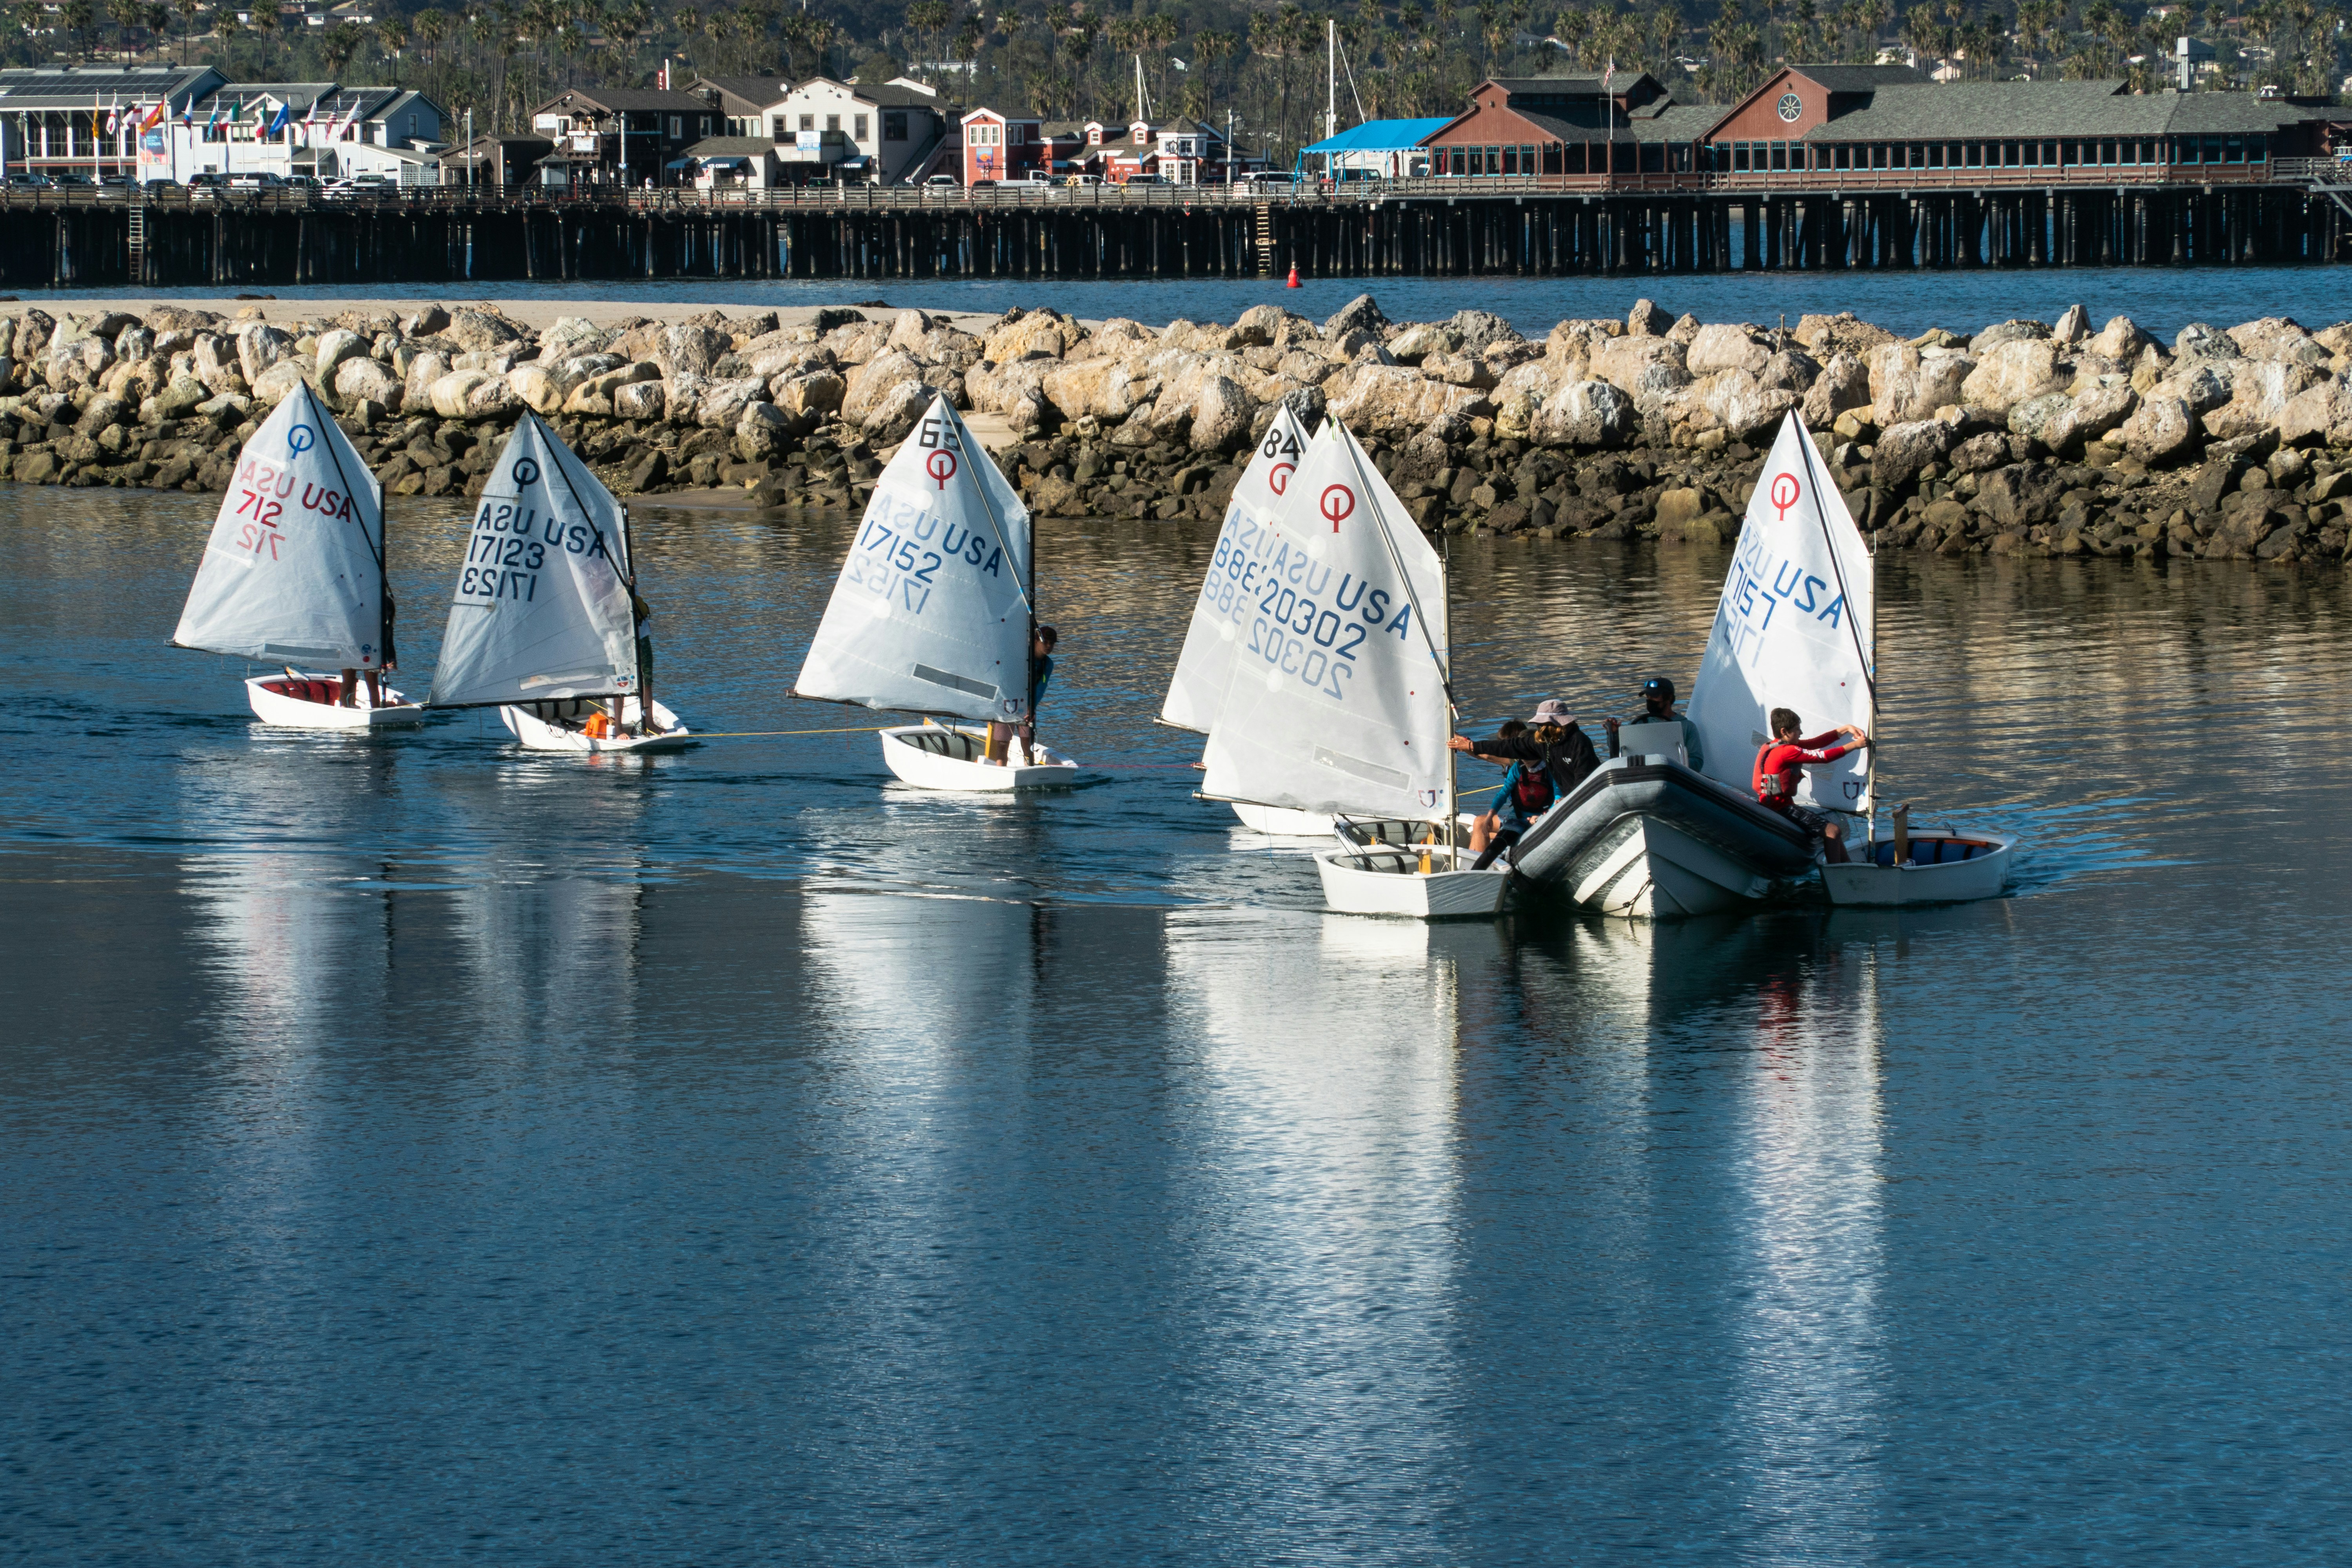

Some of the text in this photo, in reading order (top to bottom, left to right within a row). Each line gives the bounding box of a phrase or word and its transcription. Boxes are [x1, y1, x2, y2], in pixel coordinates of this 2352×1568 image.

[1264, 428, 1301, 461] 84
[236, 489, 283, 529] 712
[301, 482, 352, 523] USA
[469, 535, 546, 570] 17123
[545, 518, 605, 559] USA
[860, 520, 943, 584] 17152
[942, 523, 1002, 578] USA
[1259, 578, 1367, 662] 20302
[1336, 573, 1412, 641] USA
[1727, 557, 1777, 631] 17157
[1773, 559, 1845, 630] USA
